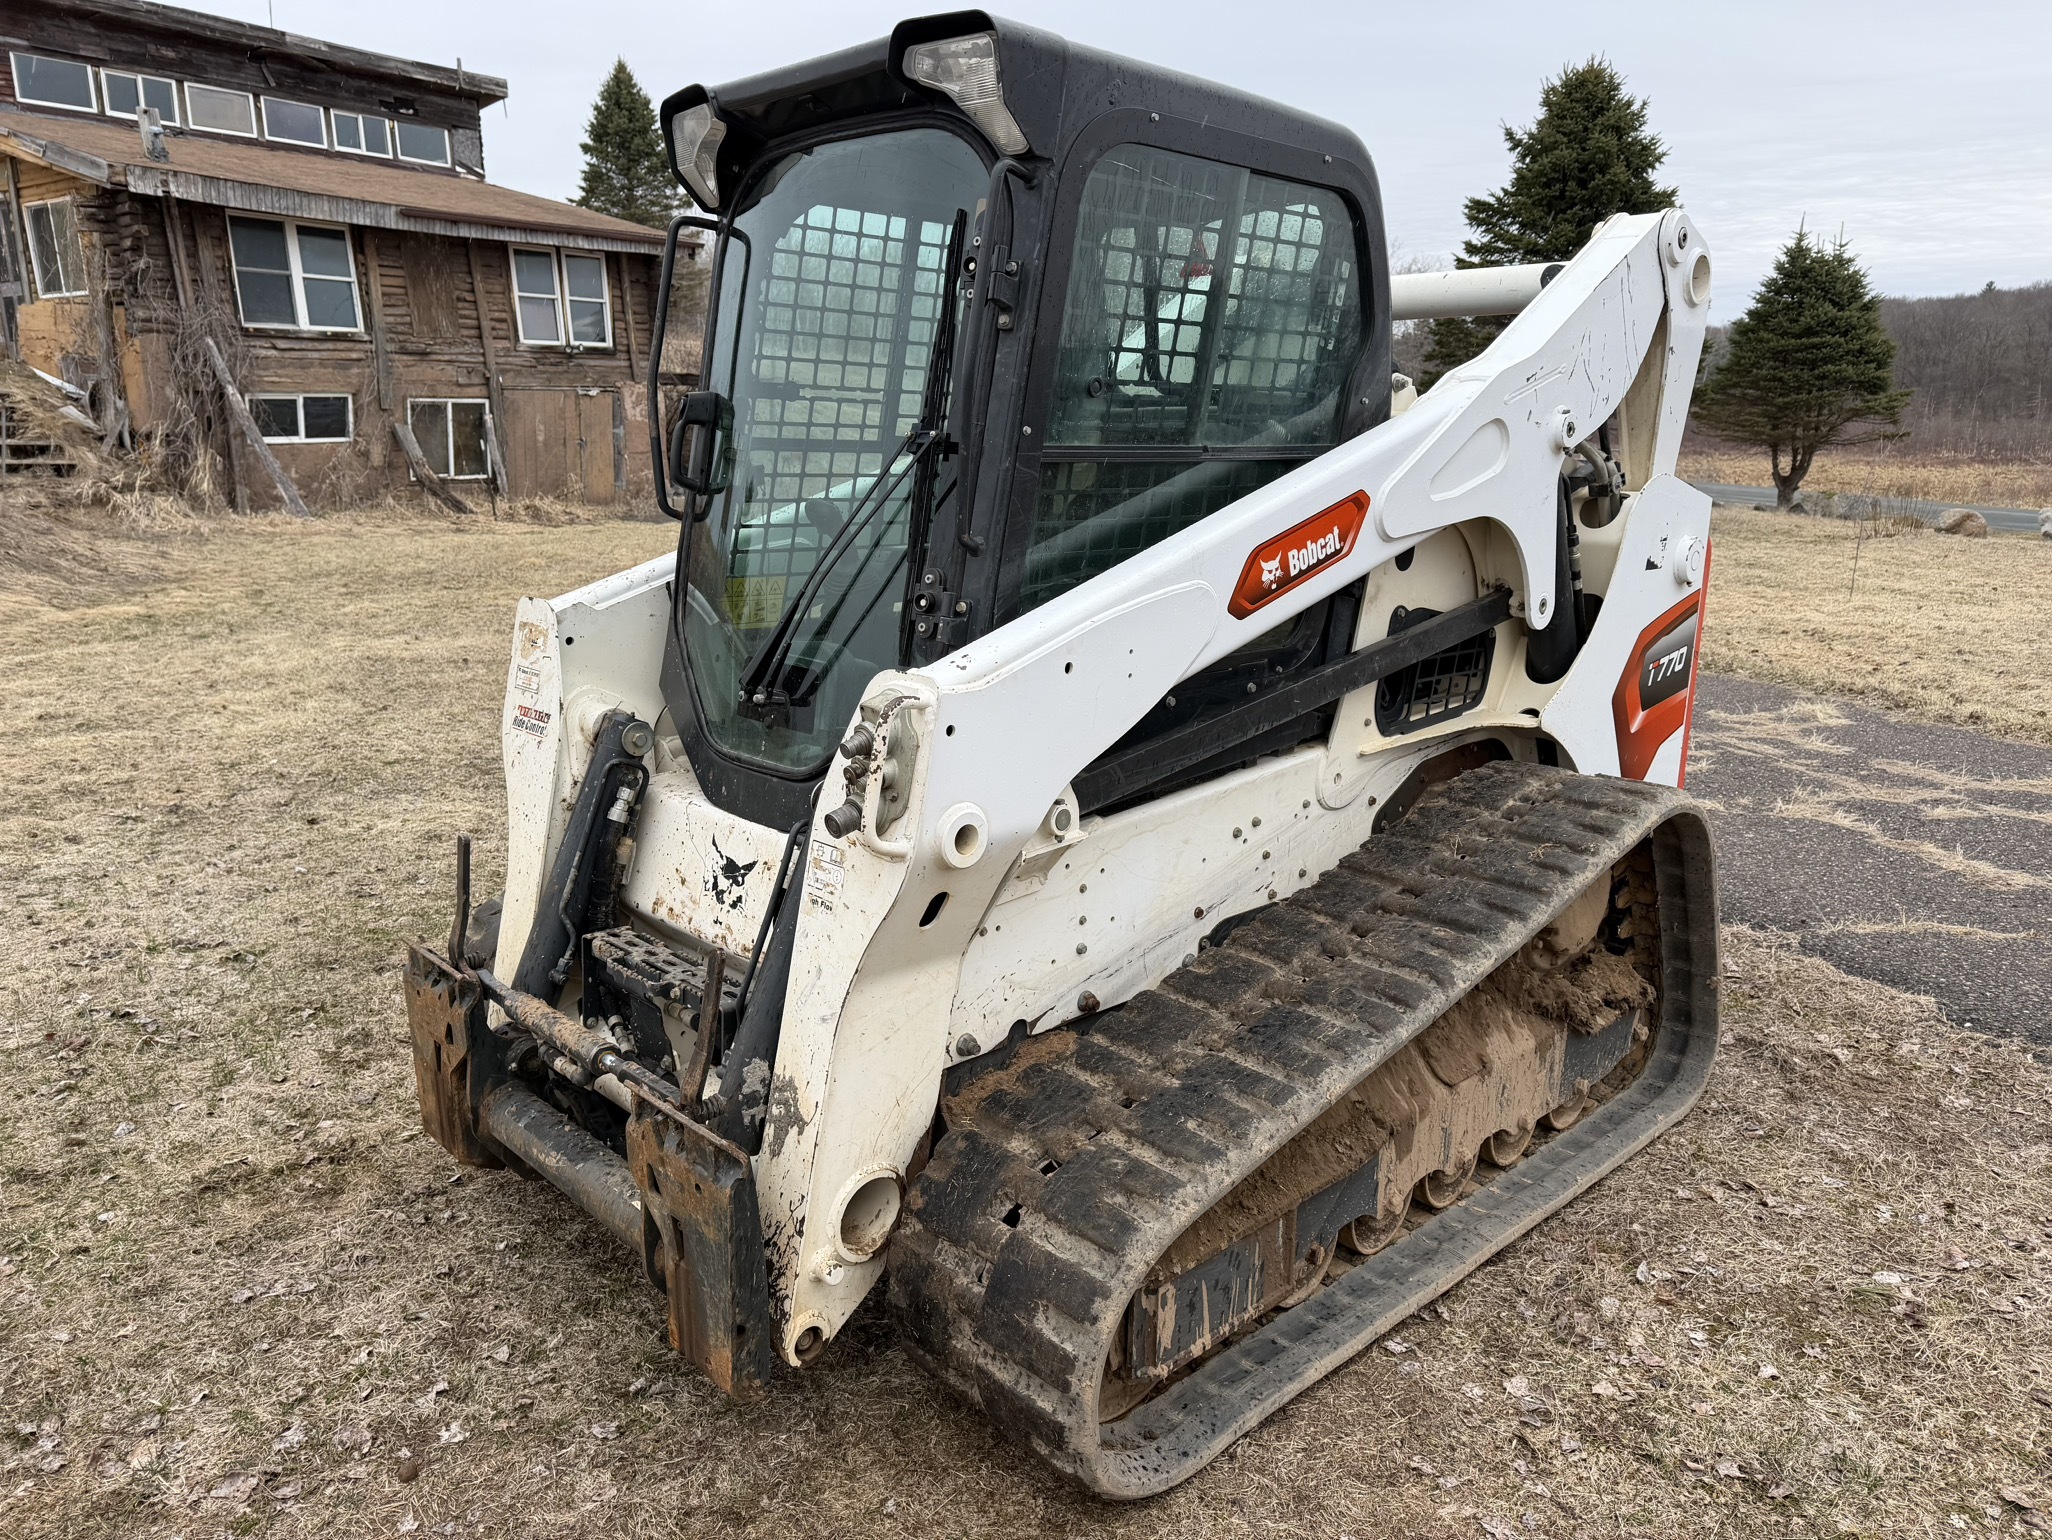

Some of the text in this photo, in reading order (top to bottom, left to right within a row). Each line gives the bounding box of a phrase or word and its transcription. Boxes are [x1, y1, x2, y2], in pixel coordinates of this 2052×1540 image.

[1287, 525, 1342, 578] Bobcat
[1647, 645, 1688, 687] T770
[512, 715, 526, 729] Ride
